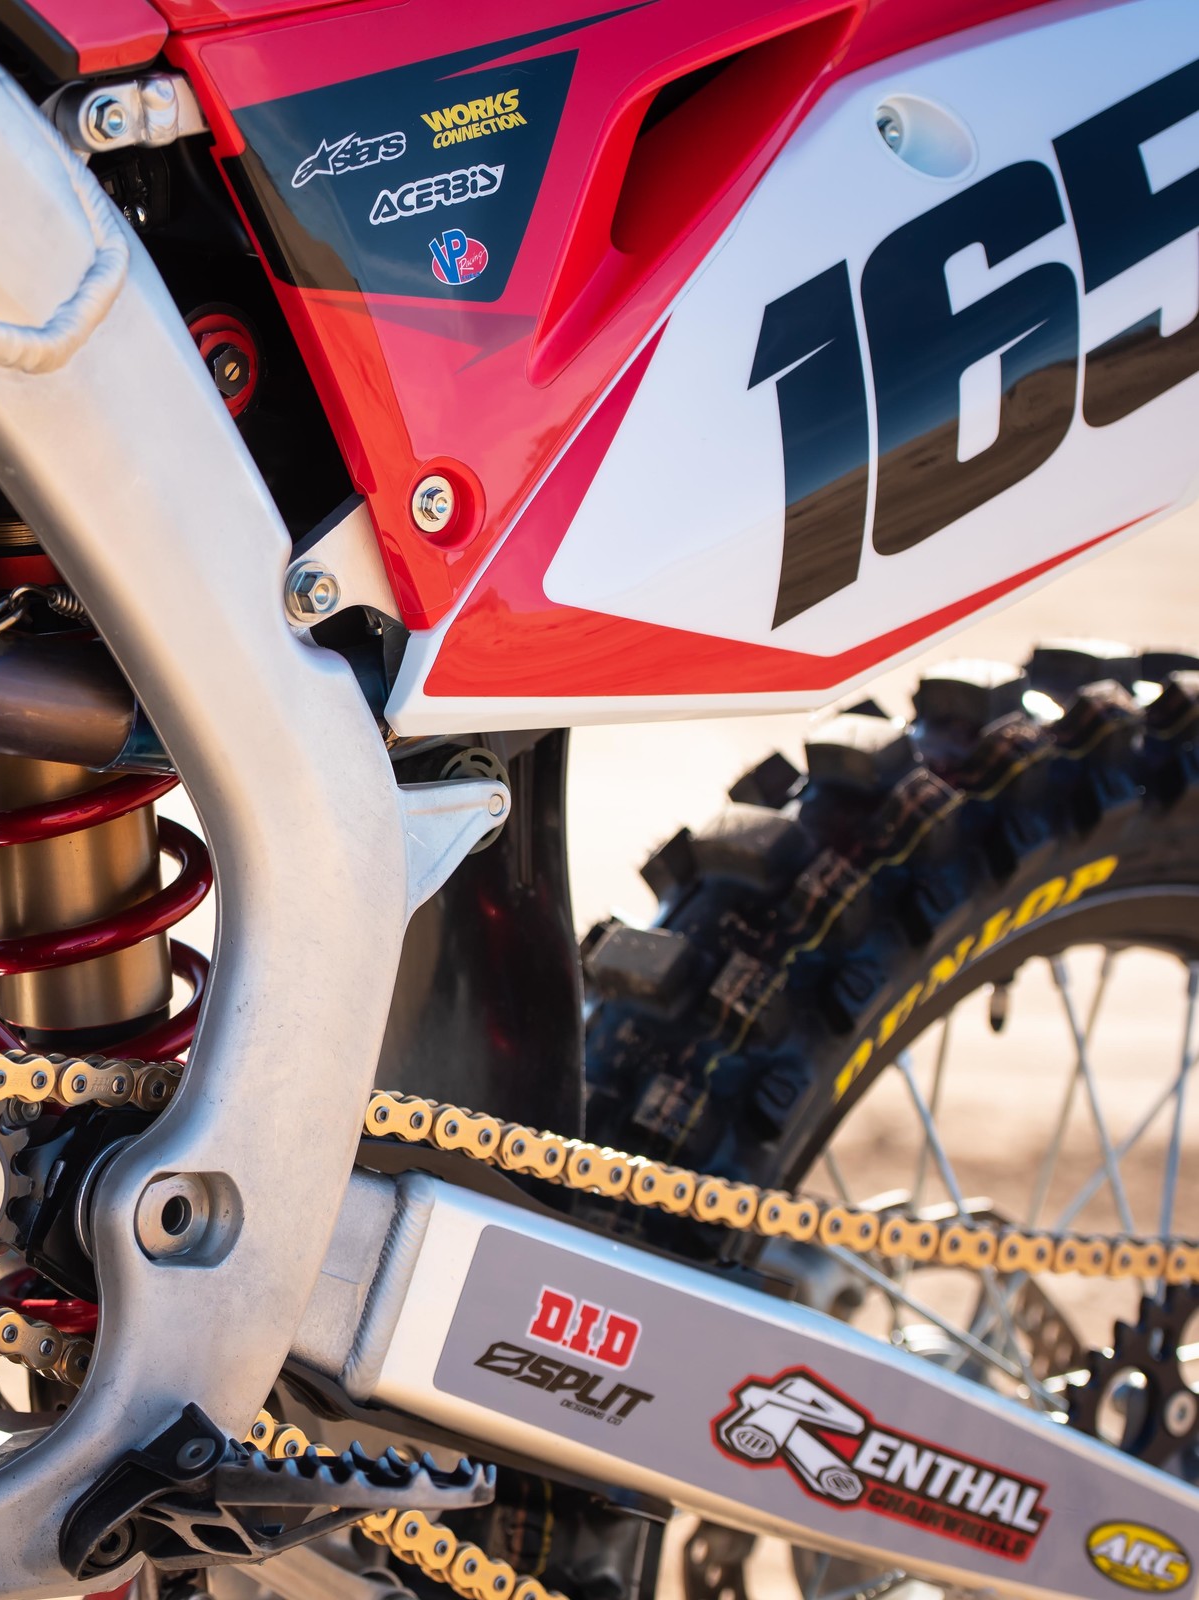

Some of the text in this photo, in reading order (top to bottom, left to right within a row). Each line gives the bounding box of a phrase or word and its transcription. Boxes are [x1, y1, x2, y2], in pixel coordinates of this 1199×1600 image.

[420, 88, 519, 133] WORKS
[432, 111, 527, 149] CONNECTION
[429, 229, 467, 283] VP
[459, 250, 485, 275] Racing
[747, 59, 1199, 631] 165
[834, 855, 1118, 1105] DUNLOP
[513, 1355, 655, 1418] SPLIT
[560, 1399, 605, 1420] DESIGNS
[1089, 1533, 1187, 1582] ARC
